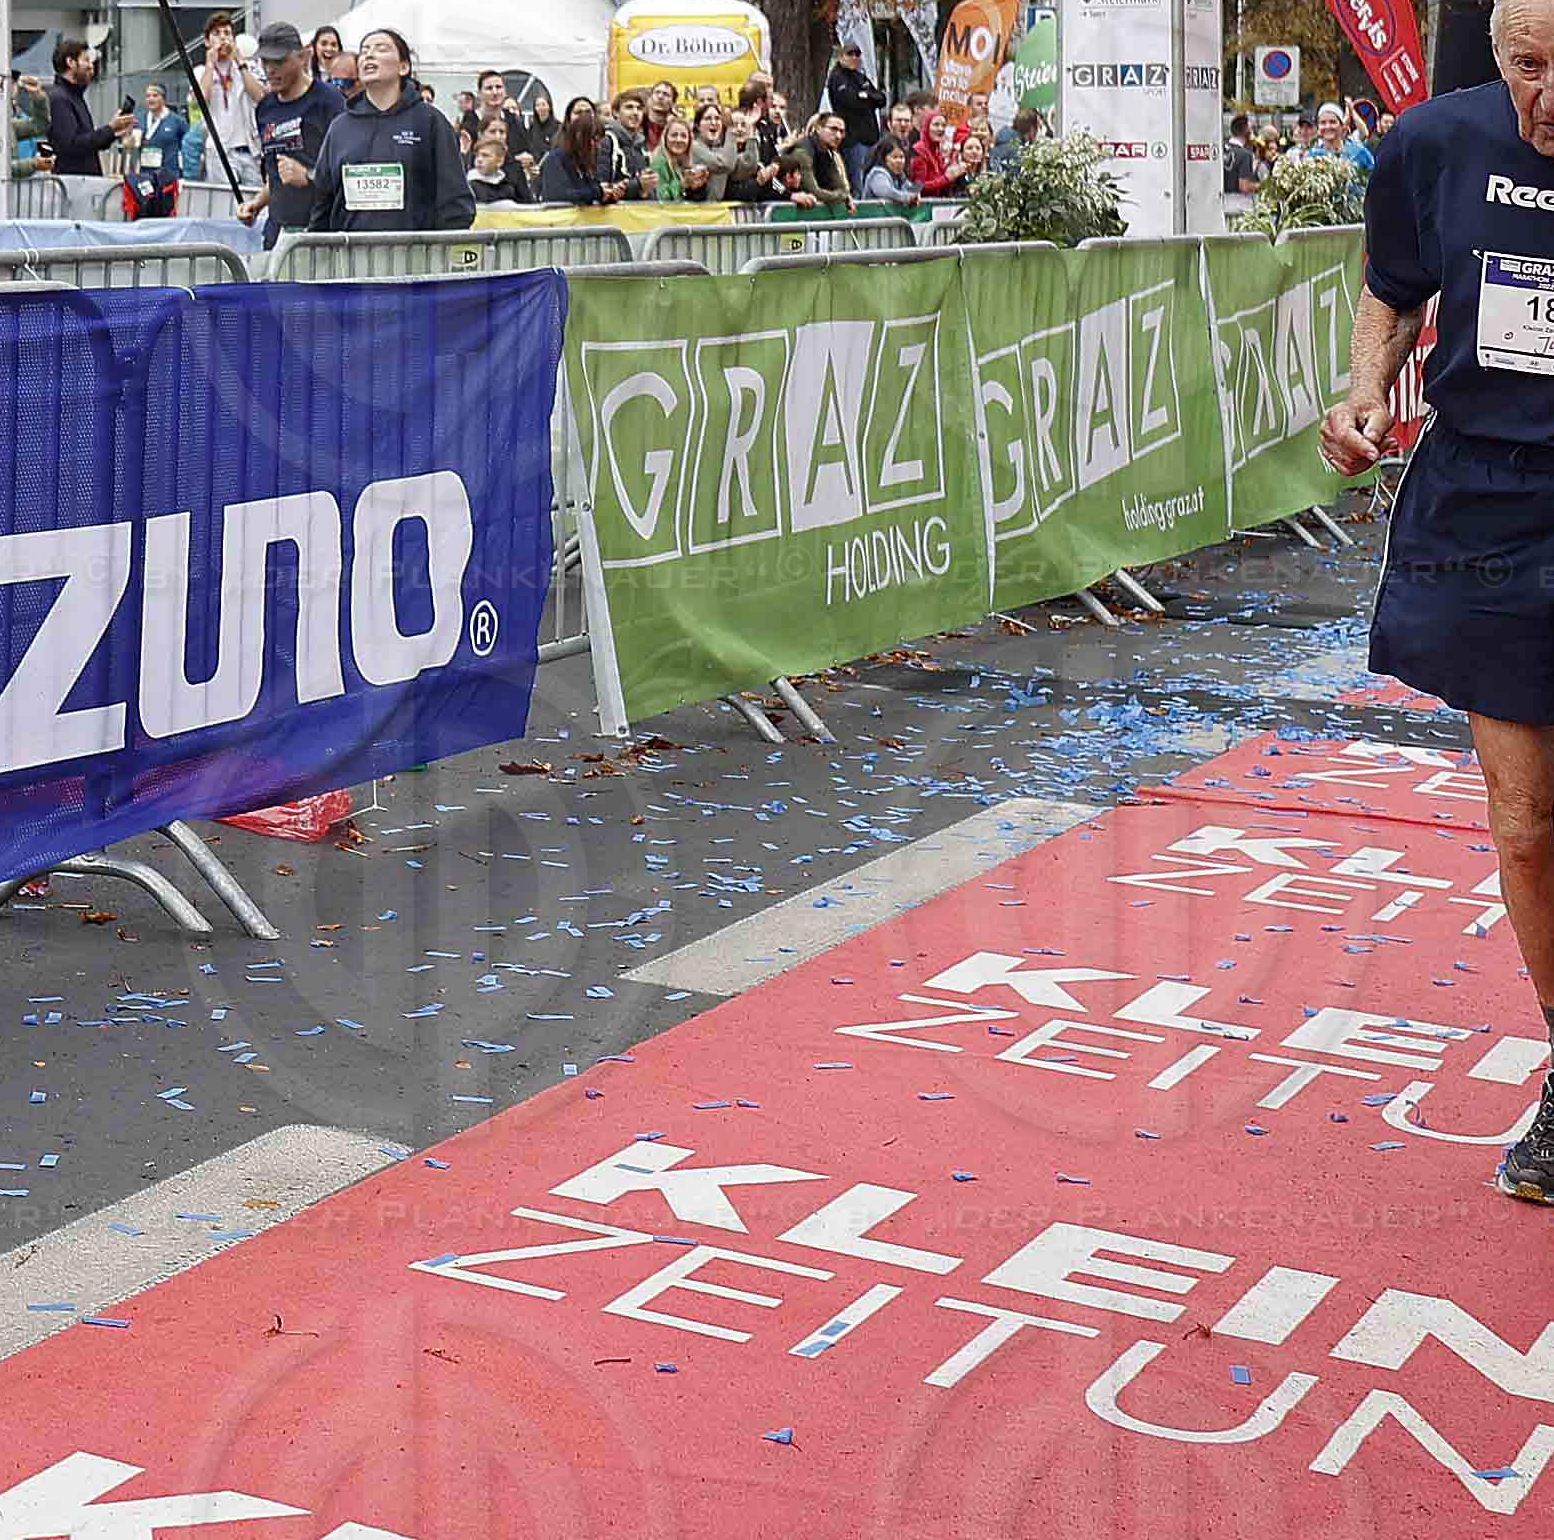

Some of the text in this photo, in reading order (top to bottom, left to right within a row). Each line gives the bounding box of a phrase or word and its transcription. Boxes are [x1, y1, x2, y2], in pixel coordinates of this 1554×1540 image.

[641, 37, 735, 54] Dr. Böhm
[1073, 63, 1165, 88] GRAZ
[356, 178, 390, 190] 13582
[593, 326, 935, 546] GRAZ
[981, 302, 1173, 526] GRAZ
[827, 515, 951, 606] HOLDING
